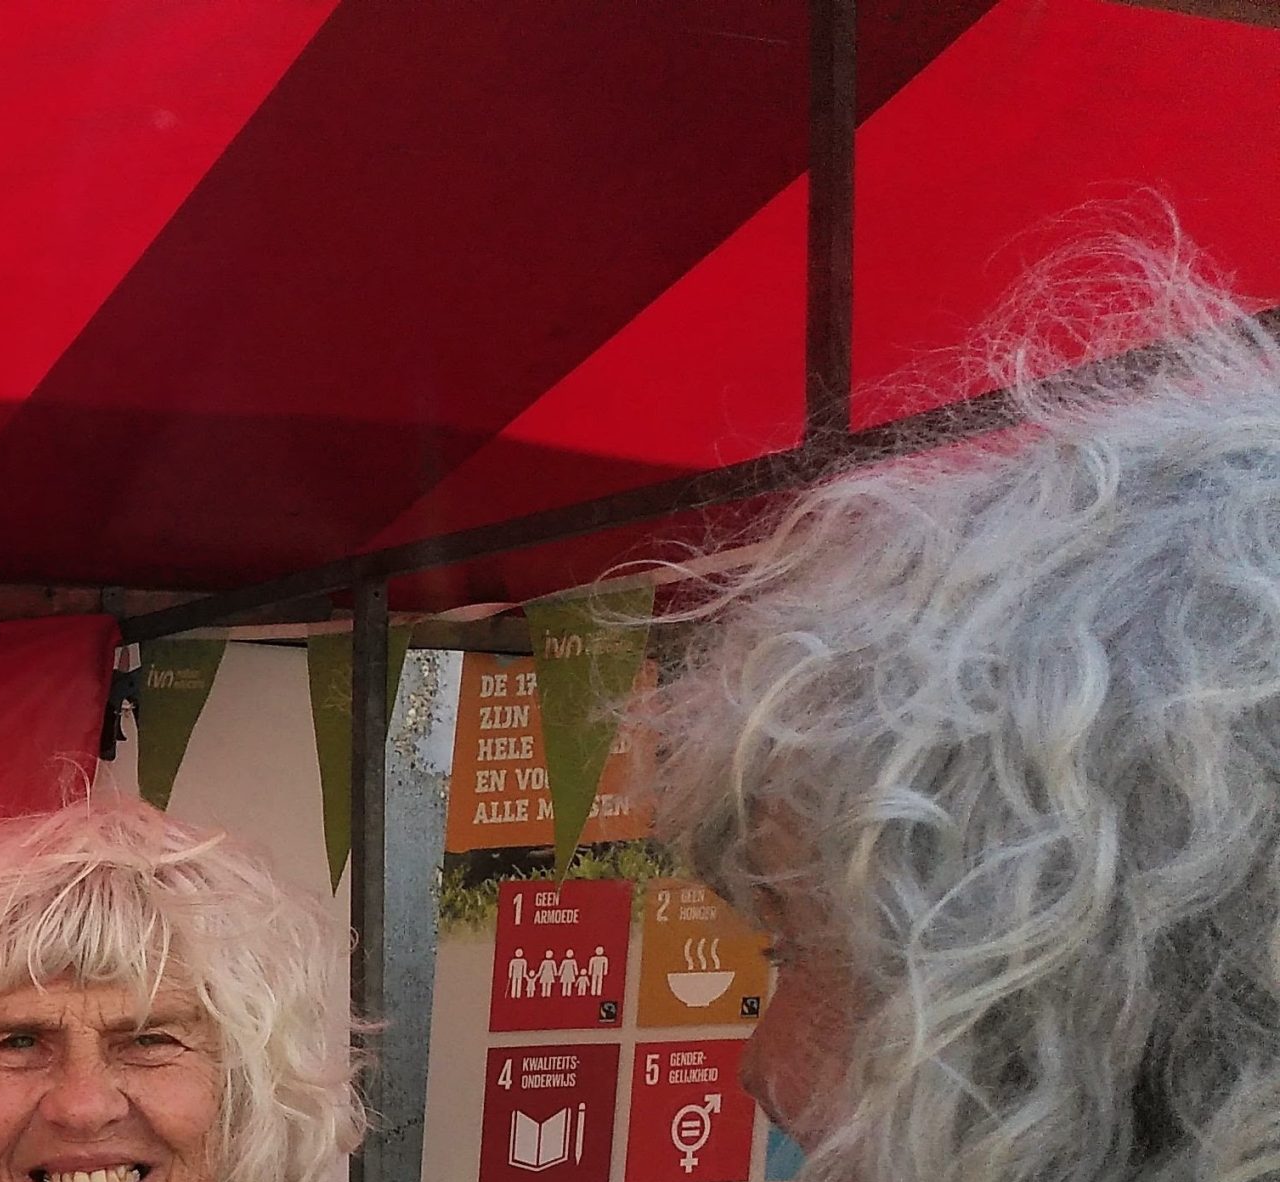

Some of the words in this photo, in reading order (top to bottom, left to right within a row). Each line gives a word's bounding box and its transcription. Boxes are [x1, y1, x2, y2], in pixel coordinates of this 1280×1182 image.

[479, 673, 508, 699] DE
[479, 704, 531, 731] ZIJN
[476, 735, 535, 763] HELE
[474, 769, 508, 794] EN
[472, 797, 530, 825] ALLE
[512, 892, 524, 926] 1
[534, 891, 562, 908] GEEN
[655, 890, 671, 923] 2
[533, 908, 581, 925] ARMOEDE
[521, 1055, 581, 1073] KWALITEITS-
[645, 1053, 661, 1086] 5
[670, 1050, 708, 1068] GENDER-
[497, 1058, 514, 1091] 4
[520, 1072, 578, 1091] ONDERWIJS
[668, 1067, 719, 1085] GELIJKHEID
